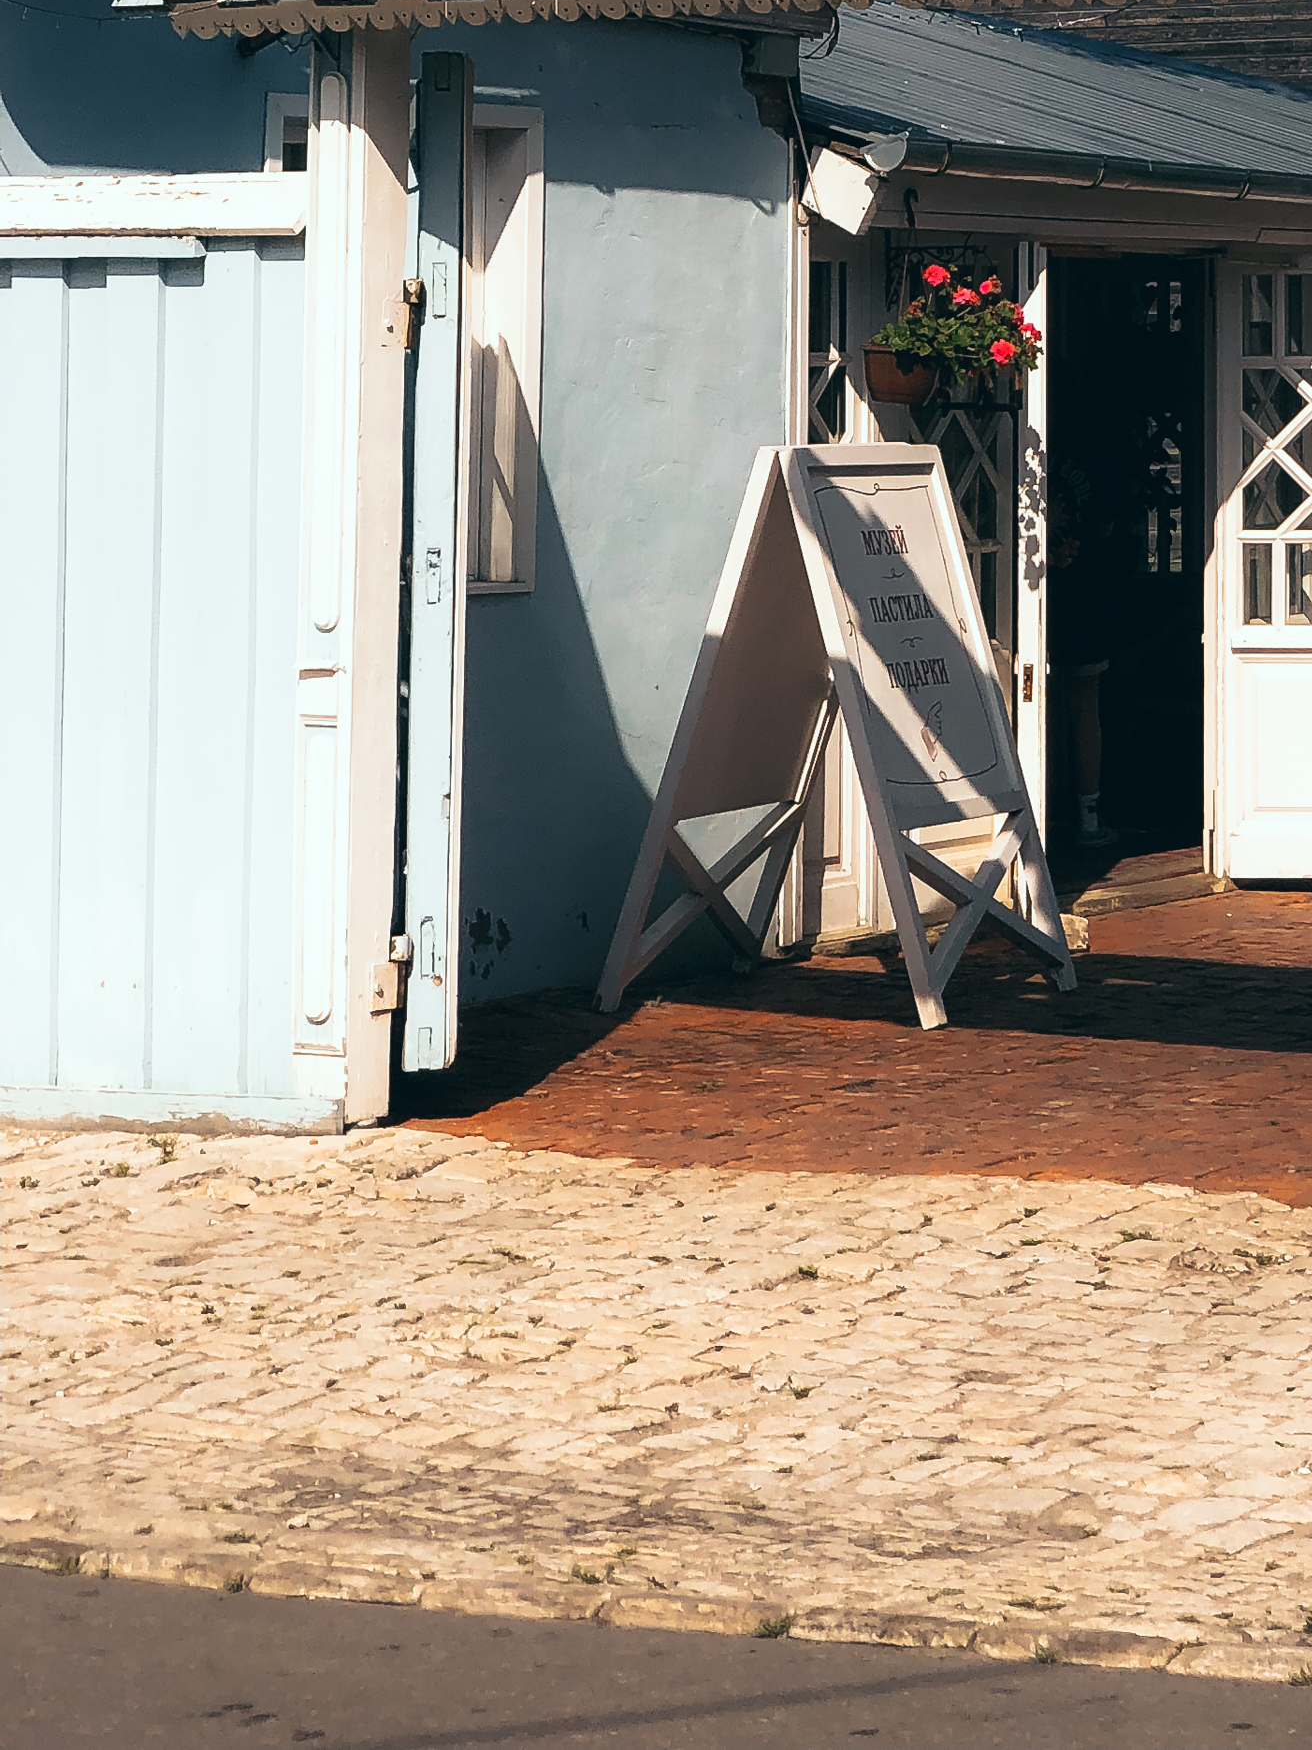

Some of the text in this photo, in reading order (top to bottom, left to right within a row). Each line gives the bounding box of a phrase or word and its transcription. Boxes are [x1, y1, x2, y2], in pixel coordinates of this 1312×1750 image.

[861, 525, 909, 555] МУЗЕЙ
[868, 593, 934, 624] ПАСТИЛА
[886, 657, 950, 692] ПОДАРКИ
